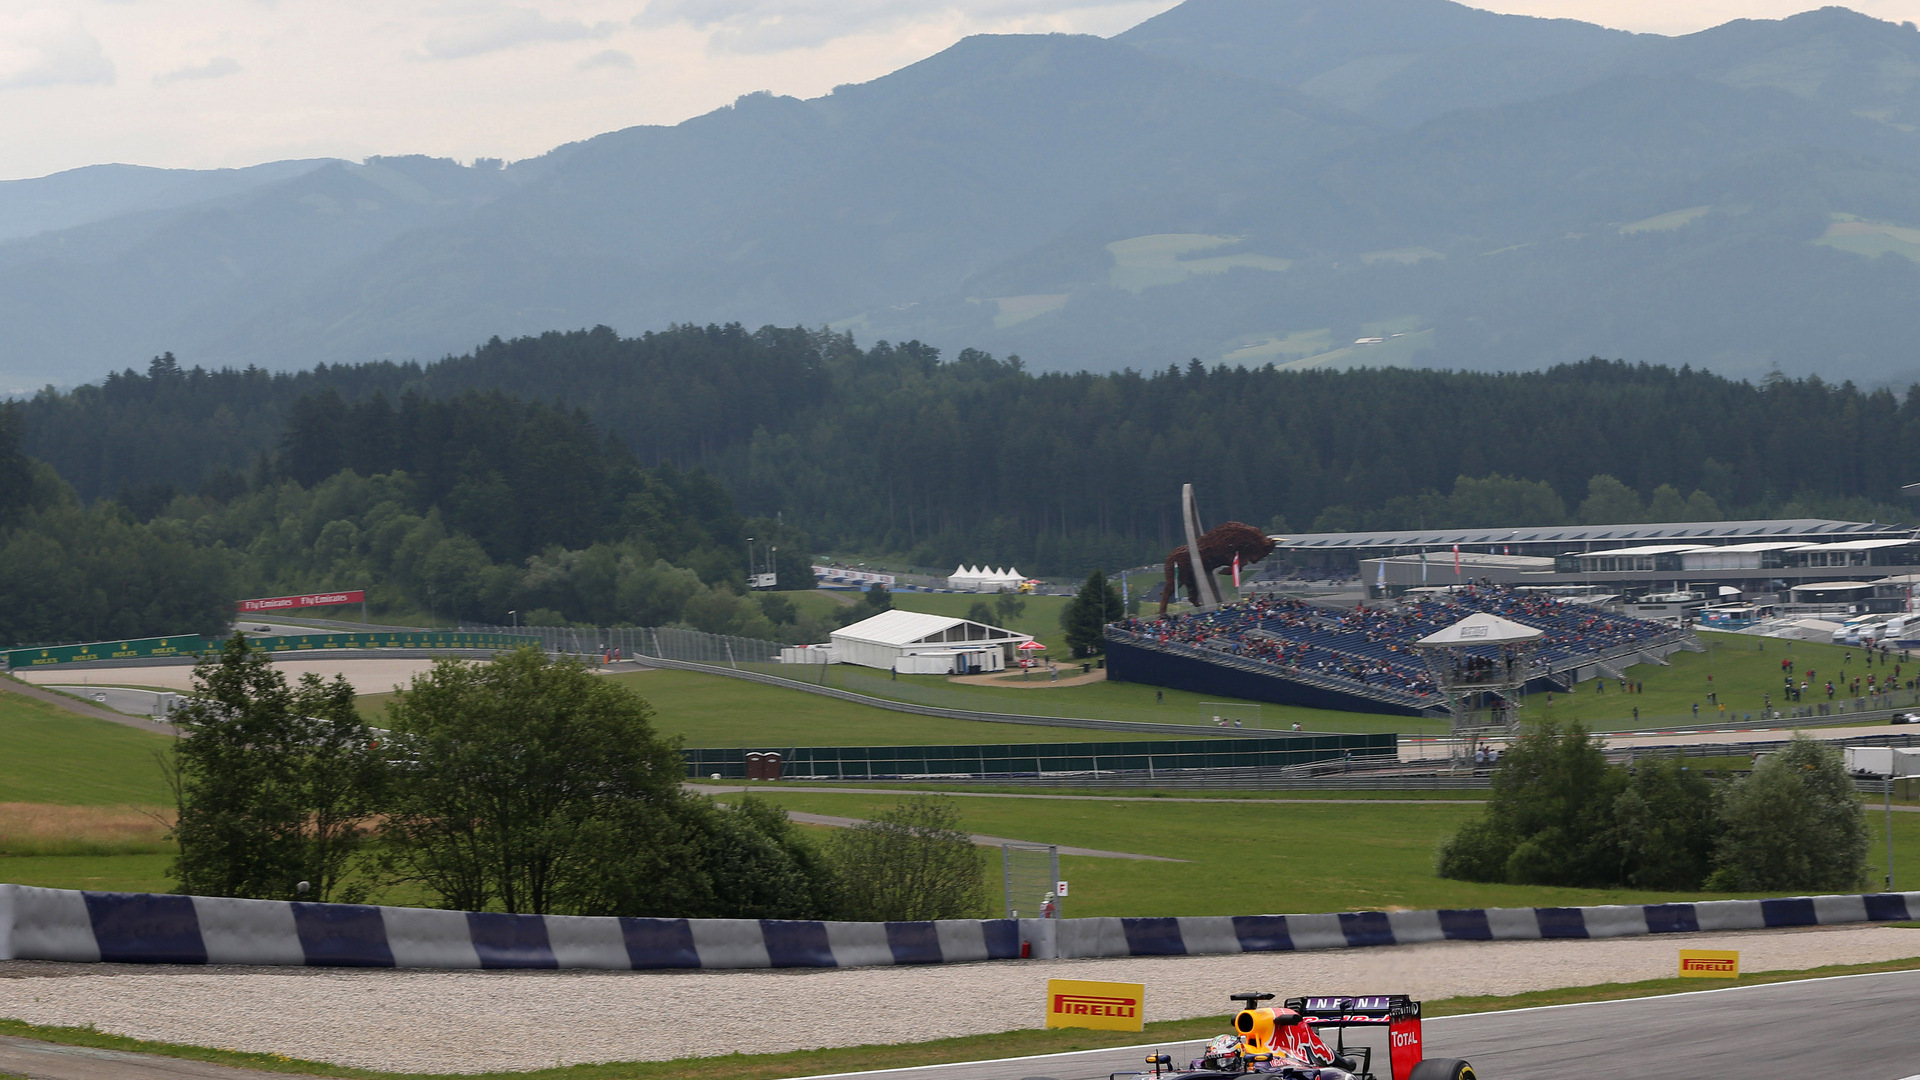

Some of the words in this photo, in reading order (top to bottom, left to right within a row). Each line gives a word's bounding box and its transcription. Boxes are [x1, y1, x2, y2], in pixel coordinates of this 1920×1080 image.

[245, 601, 259, 610] Fly
[260, 599, 293, 608] Emirates
[301, 596, 314, 605] Fly
[315, 595, 348, 604] Emirates
[1059, 884, 1066, 894] F
[1683, 958, 1735, 972] PIRELLI
[1053, 994, 1137, 1018] PIRELLI
[1391, 1031, 1418, 1048] TOTAL
